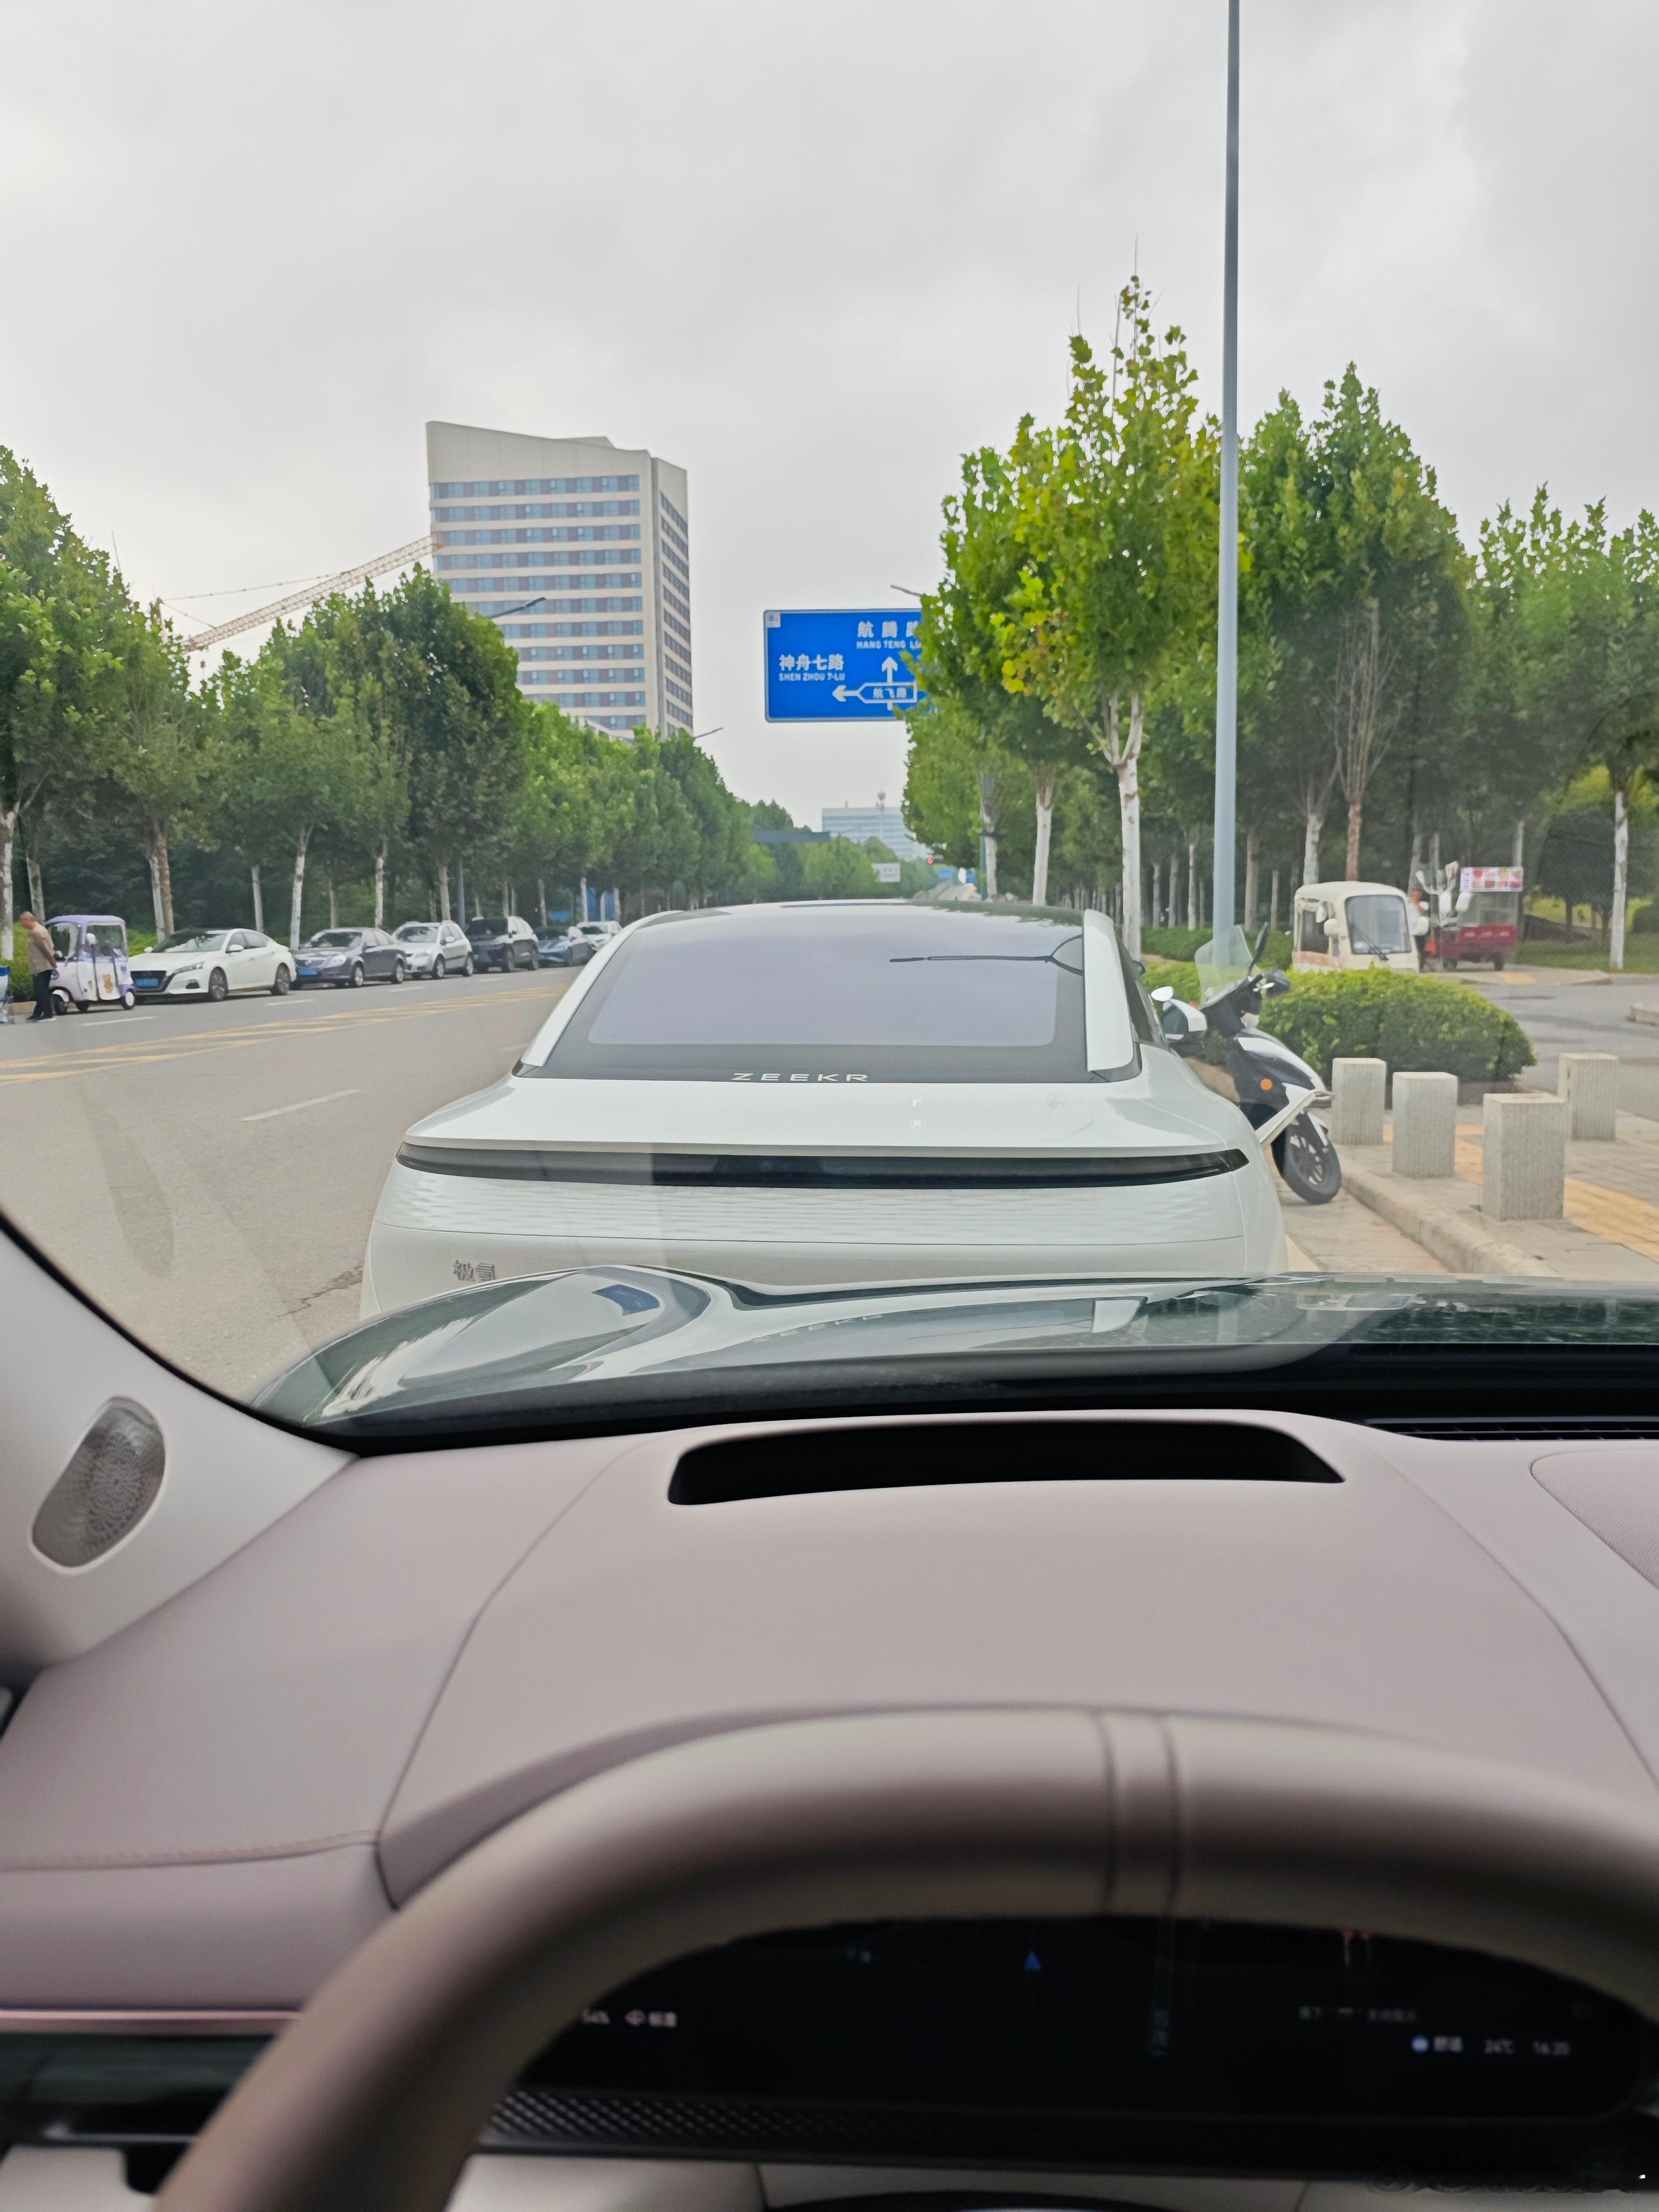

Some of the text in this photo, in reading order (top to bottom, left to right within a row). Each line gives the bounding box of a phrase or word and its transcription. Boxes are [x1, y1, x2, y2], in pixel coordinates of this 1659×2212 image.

[857, 640, 881, 649] HANG
[884, 640, 906, 649] TENG
[779, 653, 844, 671] 神舟七路
[779, 673, 801, 681] SHEN
[802, 673, 825, 681] ZHOU
[731, 1073, 868, 1081] ZEEKR
